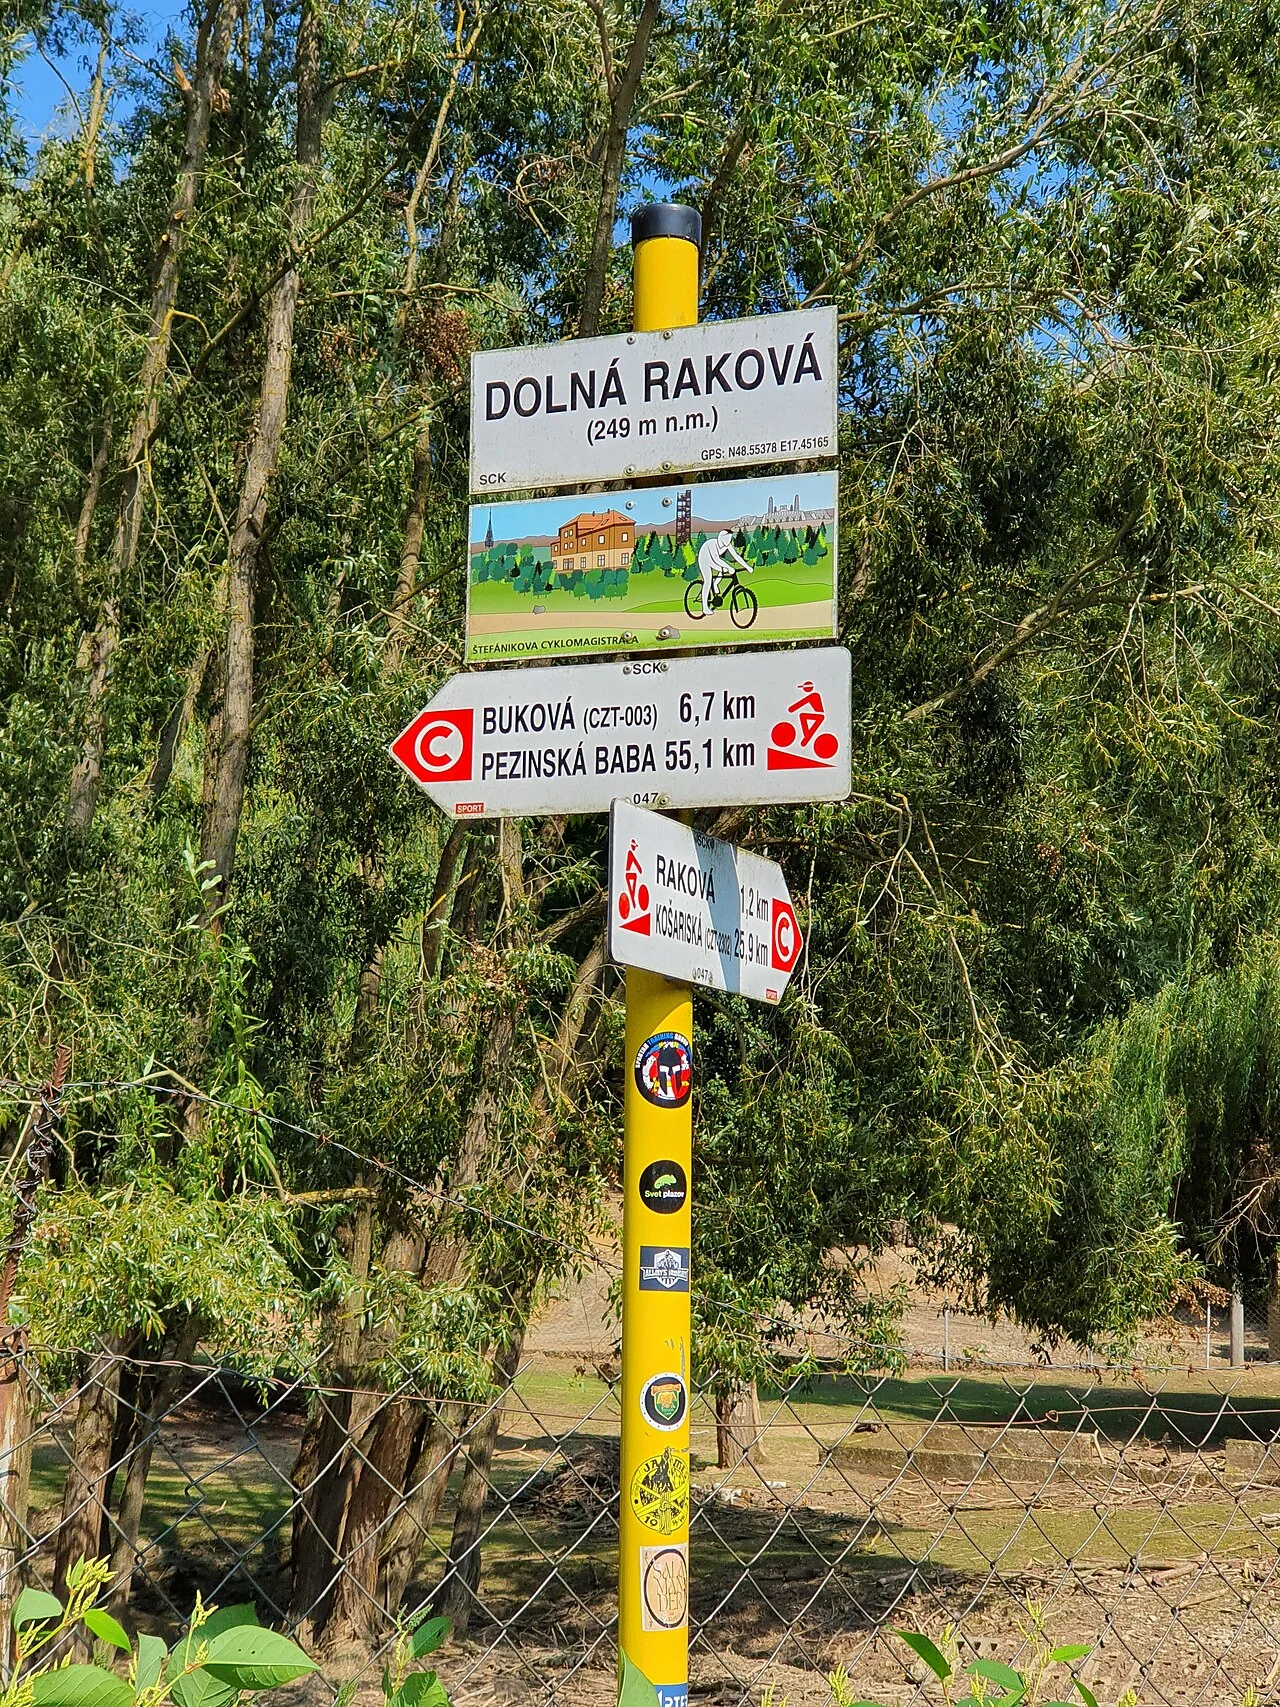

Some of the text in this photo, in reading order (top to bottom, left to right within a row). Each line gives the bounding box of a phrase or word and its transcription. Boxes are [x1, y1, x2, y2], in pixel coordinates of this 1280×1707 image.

[485, 332, 823, 421] DOLNÁ RAKOVÁ
[587, 406, 719, 446] (249 m n.m.)
[701, 436, 829, 461] GPS: N48.55378 E17.45165
[479, 472, 506, 486] SCK
[473, 641, 538, 654] ŠTEFÁNIKOVA
[632, 662, 662, 675] SCK
[482, 690, 755, 735] BUKOVÁ (CZT-003) 6,7 km
[482, 737, 755, 780] PEZINSKÁ BABA 55,1 km
[457, 804, 482, 813] SPORT
[633, 792, 658, 804] 047
[656, 854, 769, 922] RAKOVÁ 1,2 km
[656, 899, 703, 947] KOŠARISKÁ
[734, 928, 753, 965] 25,9
[755, 935, 768, 967] km
[644, 1190, 662, 1198] Svet
